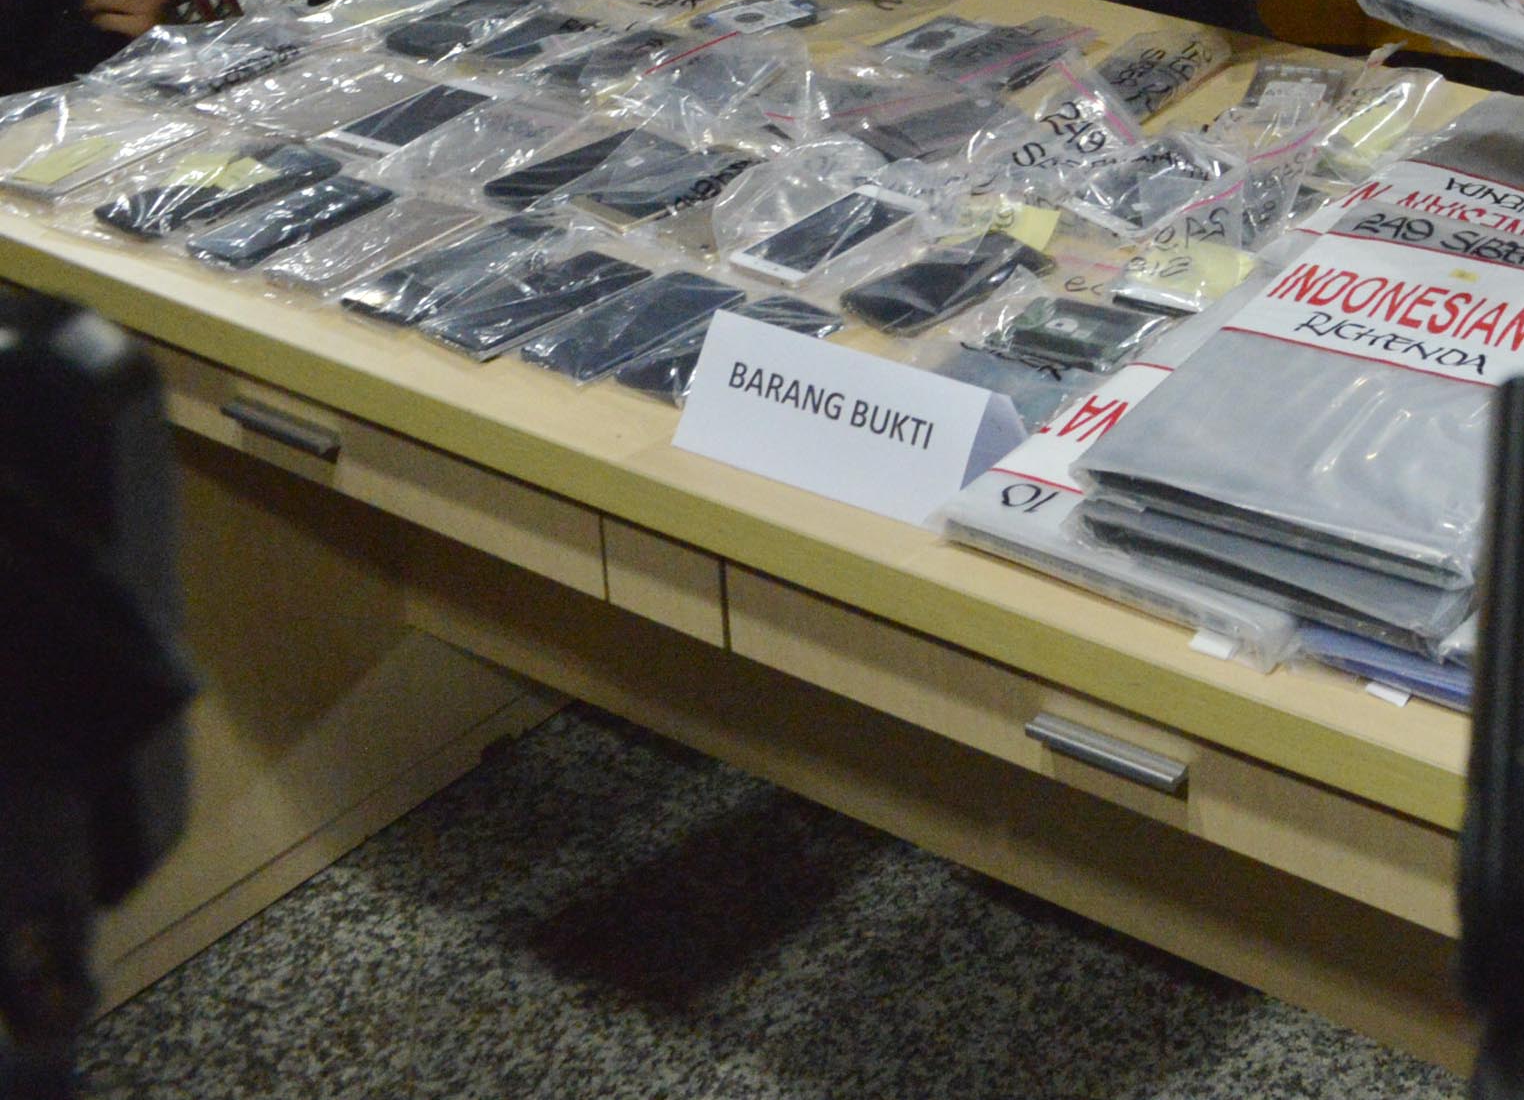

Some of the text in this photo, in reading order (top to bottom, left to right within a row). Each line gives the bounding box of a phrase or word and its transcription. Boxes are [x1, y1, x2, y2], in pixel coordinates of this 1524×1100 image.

[1039, 101, 1107, 154] 249
[1353, 213, 1435, 242] 249
[1295, 311, 1488, 375] RICHENDA
[728, 362, 934, 449] BARANG BUKTI
[1040, 395, 1128, 442] NA
